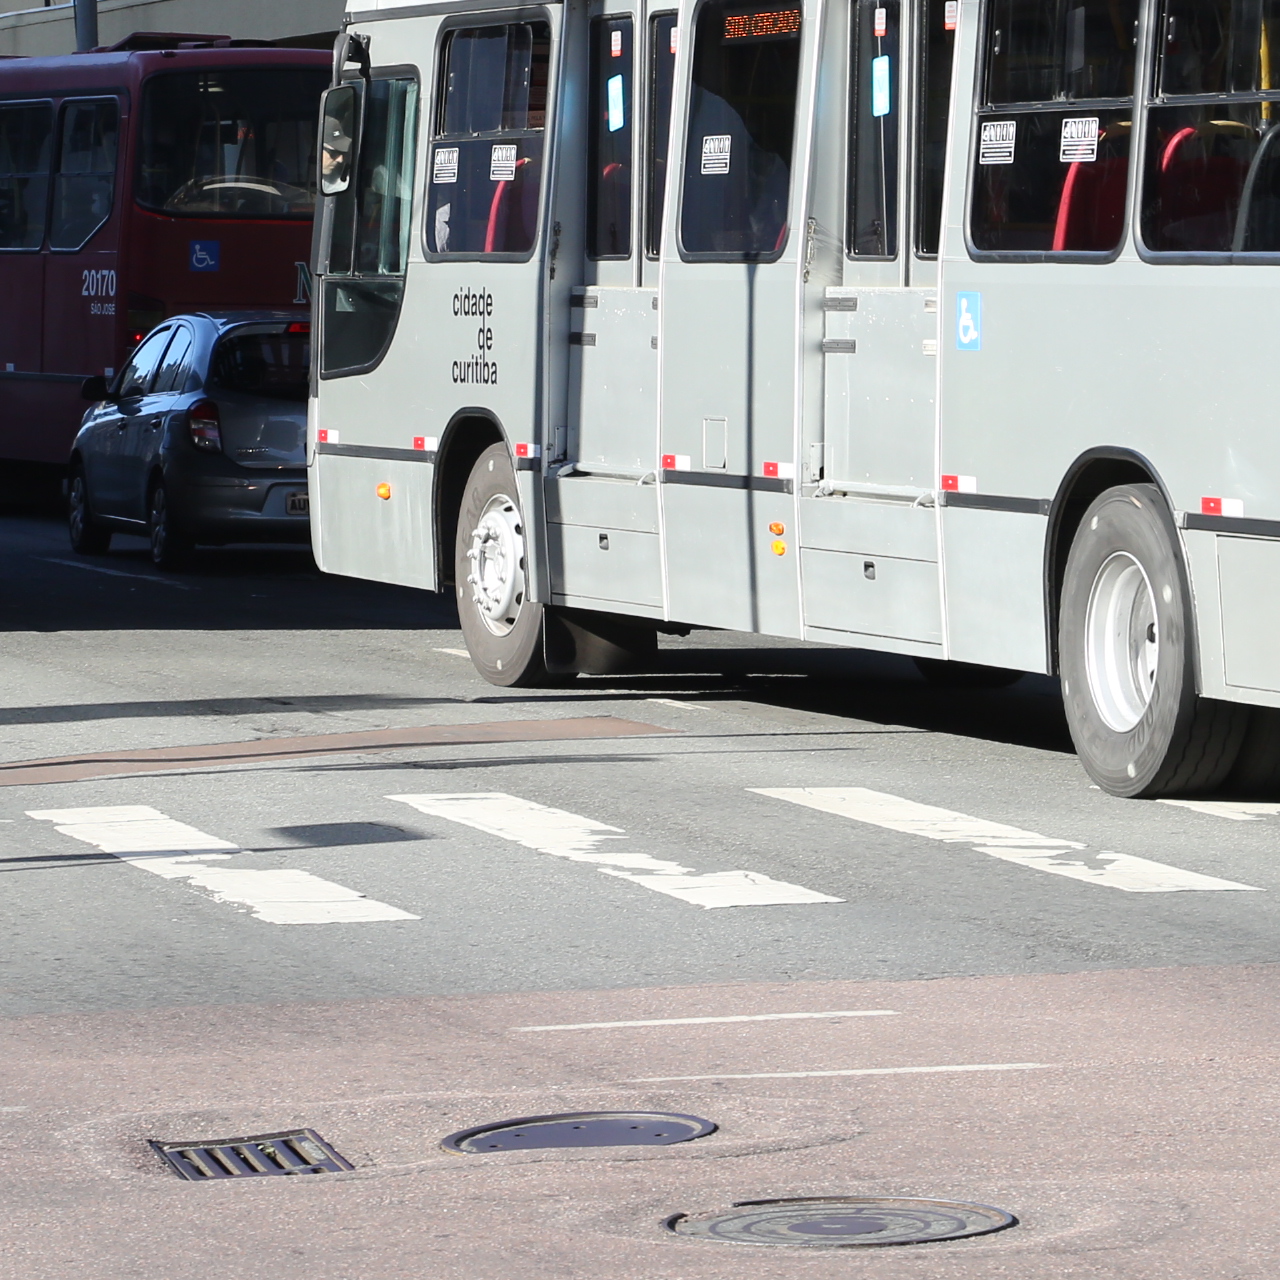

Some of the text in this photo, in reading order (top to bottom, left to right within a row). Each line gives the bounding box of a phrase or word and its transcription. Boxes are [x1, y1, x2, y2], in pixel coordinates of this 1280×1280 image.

[81, 269, 116, 297] 20170
[90, 301, 116, 315] SÃO JOSÉ
[452, 286, 493, 318] cidade
[477, 325, 493, 352] de
[451, 356, 498, 385] curitiba
